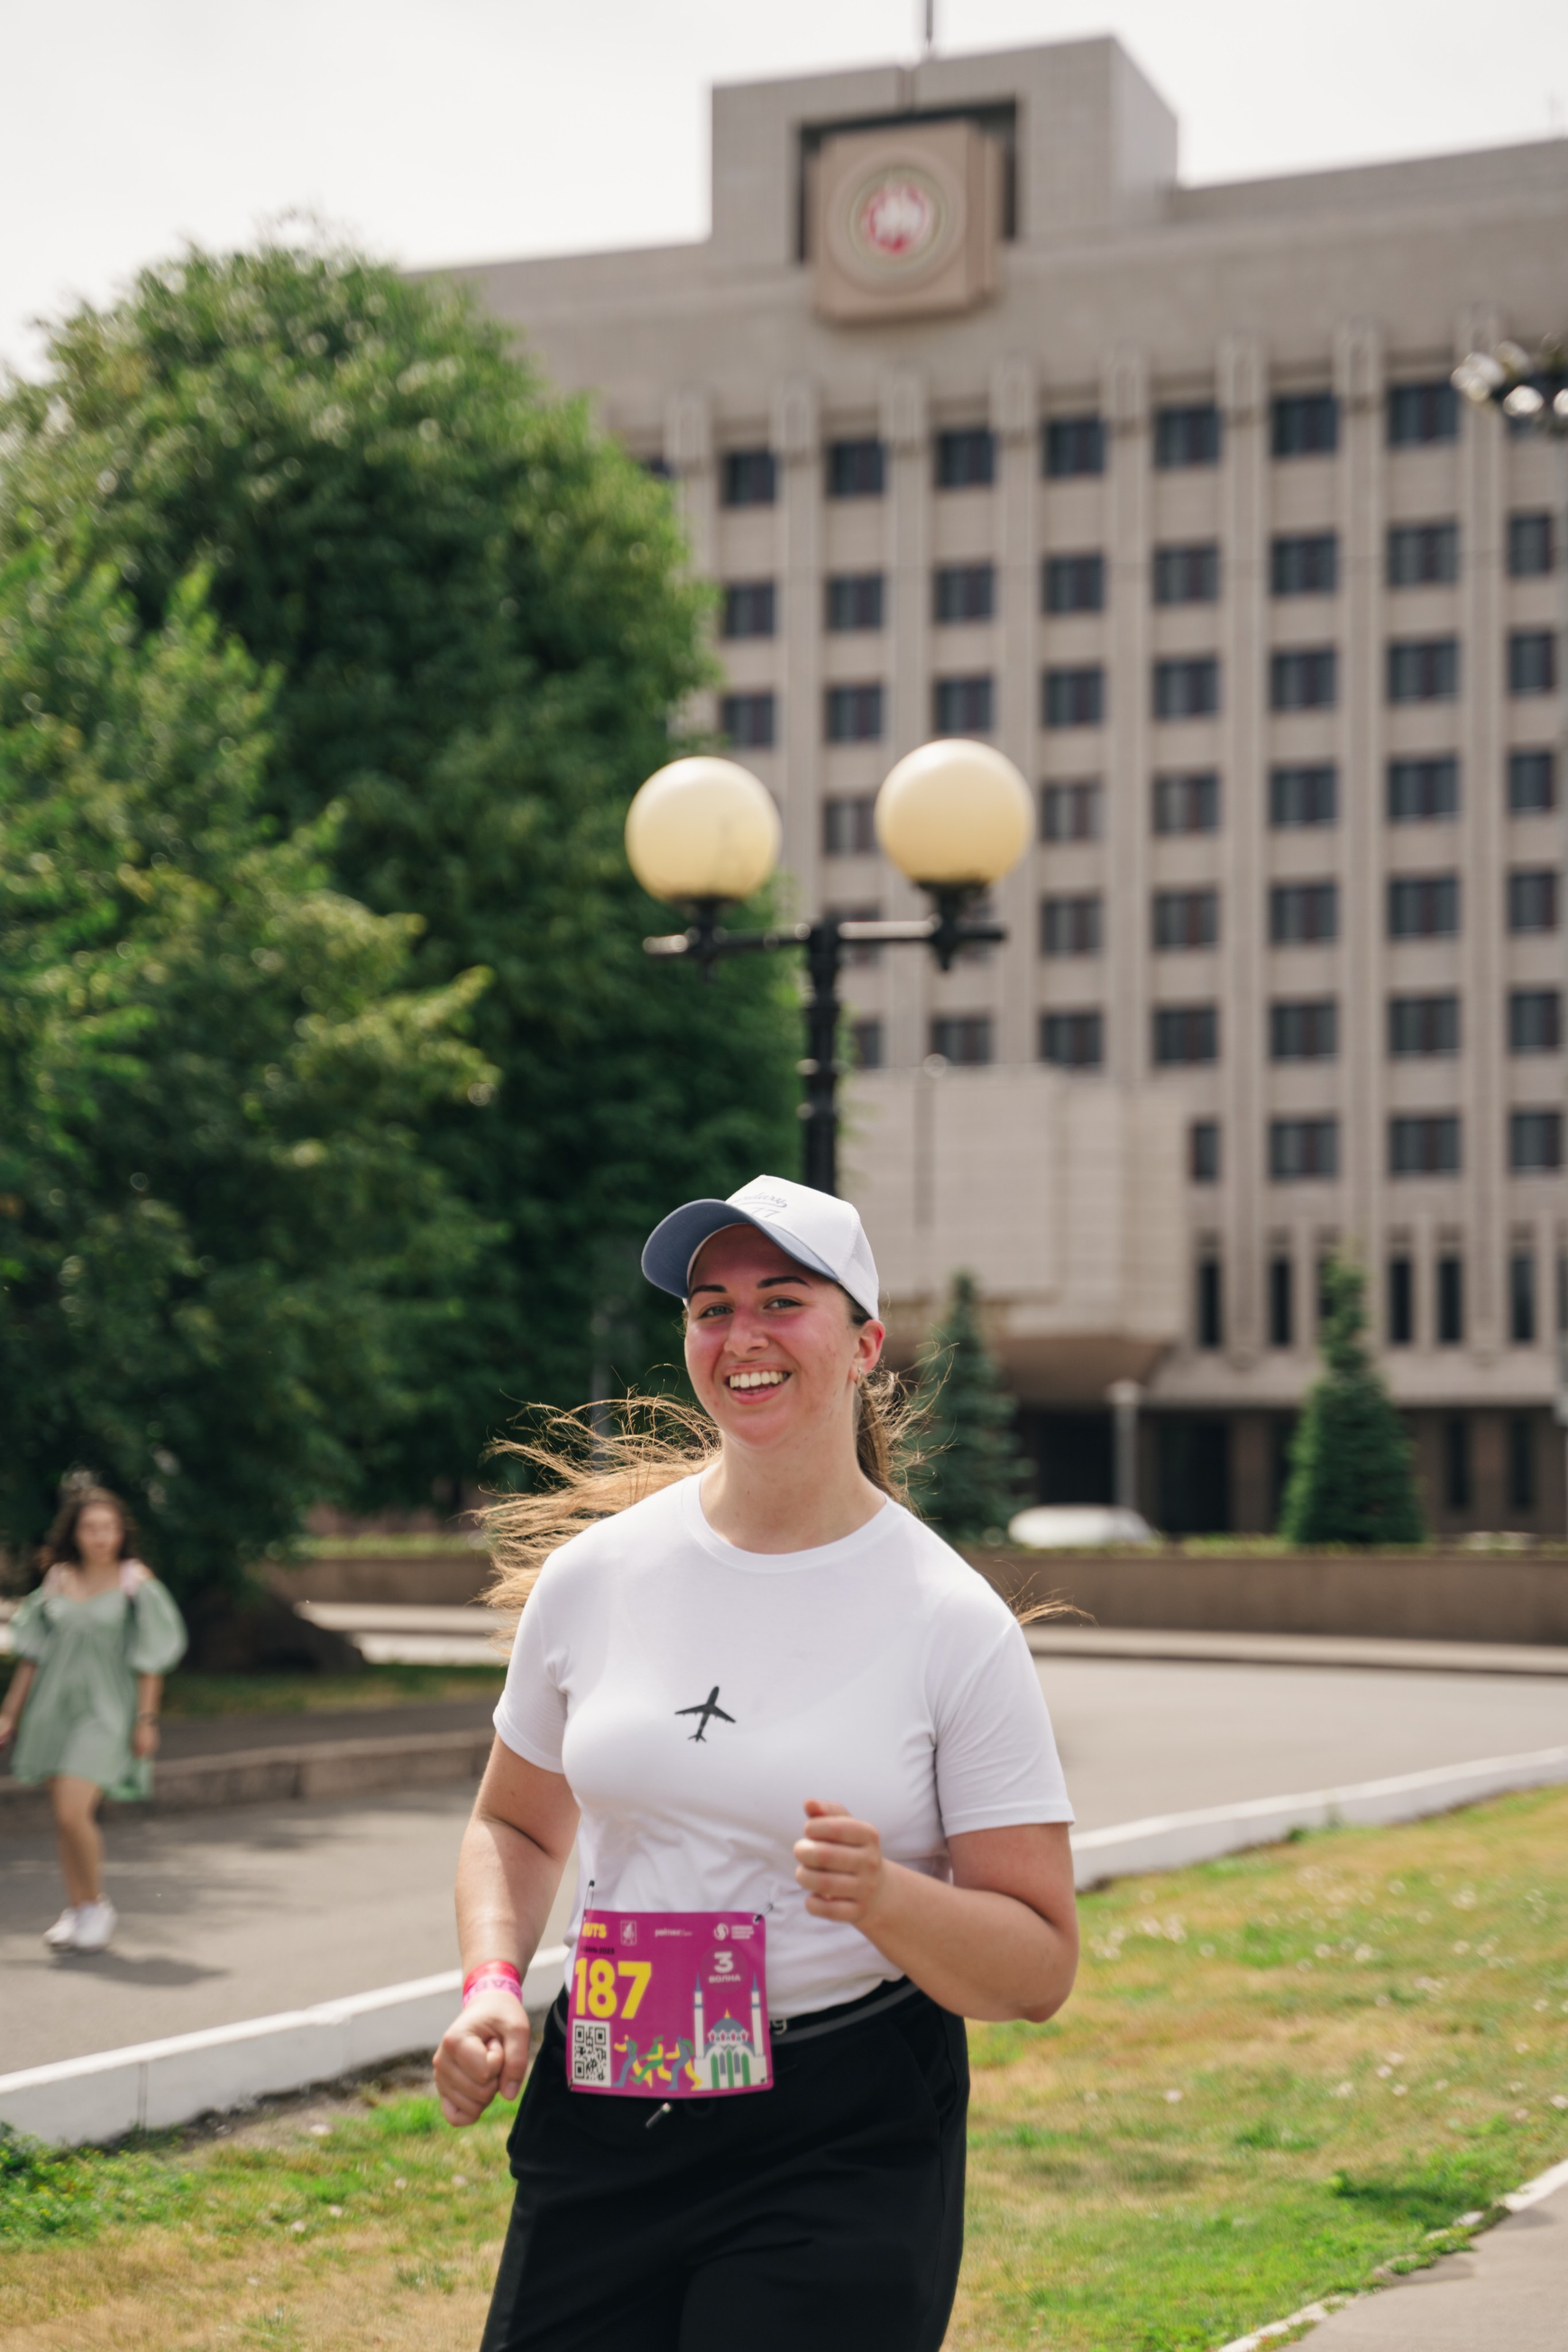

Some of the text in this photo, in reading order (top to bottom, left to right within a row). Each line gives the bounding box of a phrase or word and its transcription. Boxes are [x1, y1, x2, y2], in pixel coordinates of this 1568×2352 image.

[714, 1951, 734, 1973] 3
[575, 1958, 652, 2019] 187
[709, 1974, 741, 1983] ВОЛНА
